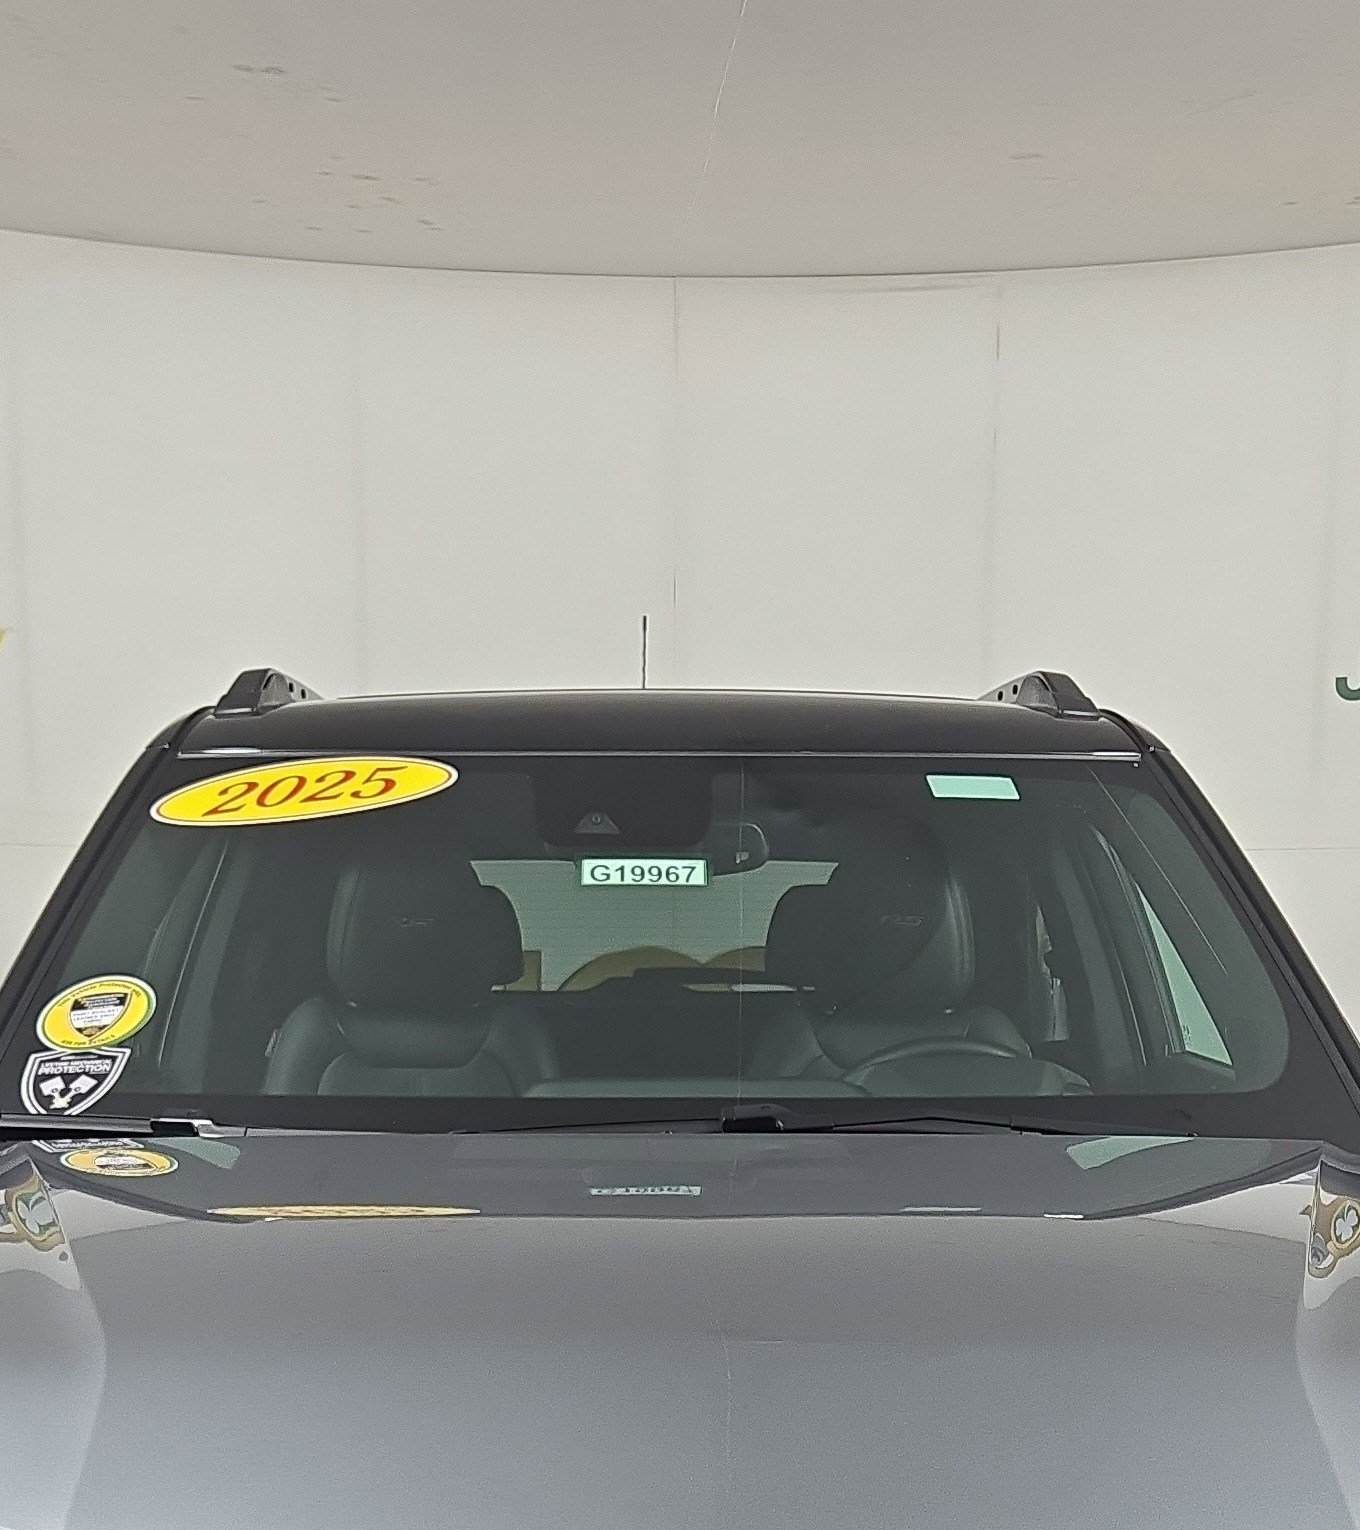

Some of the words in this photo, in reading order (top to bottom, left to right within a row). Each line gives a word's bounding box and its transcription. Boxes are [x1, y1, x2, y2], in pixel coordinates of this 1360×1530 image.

[201, 766, 408, 817] 2025
[590, 864, 697, 883] G19967
[37, 1063, 112, 1076] PROTECTION
